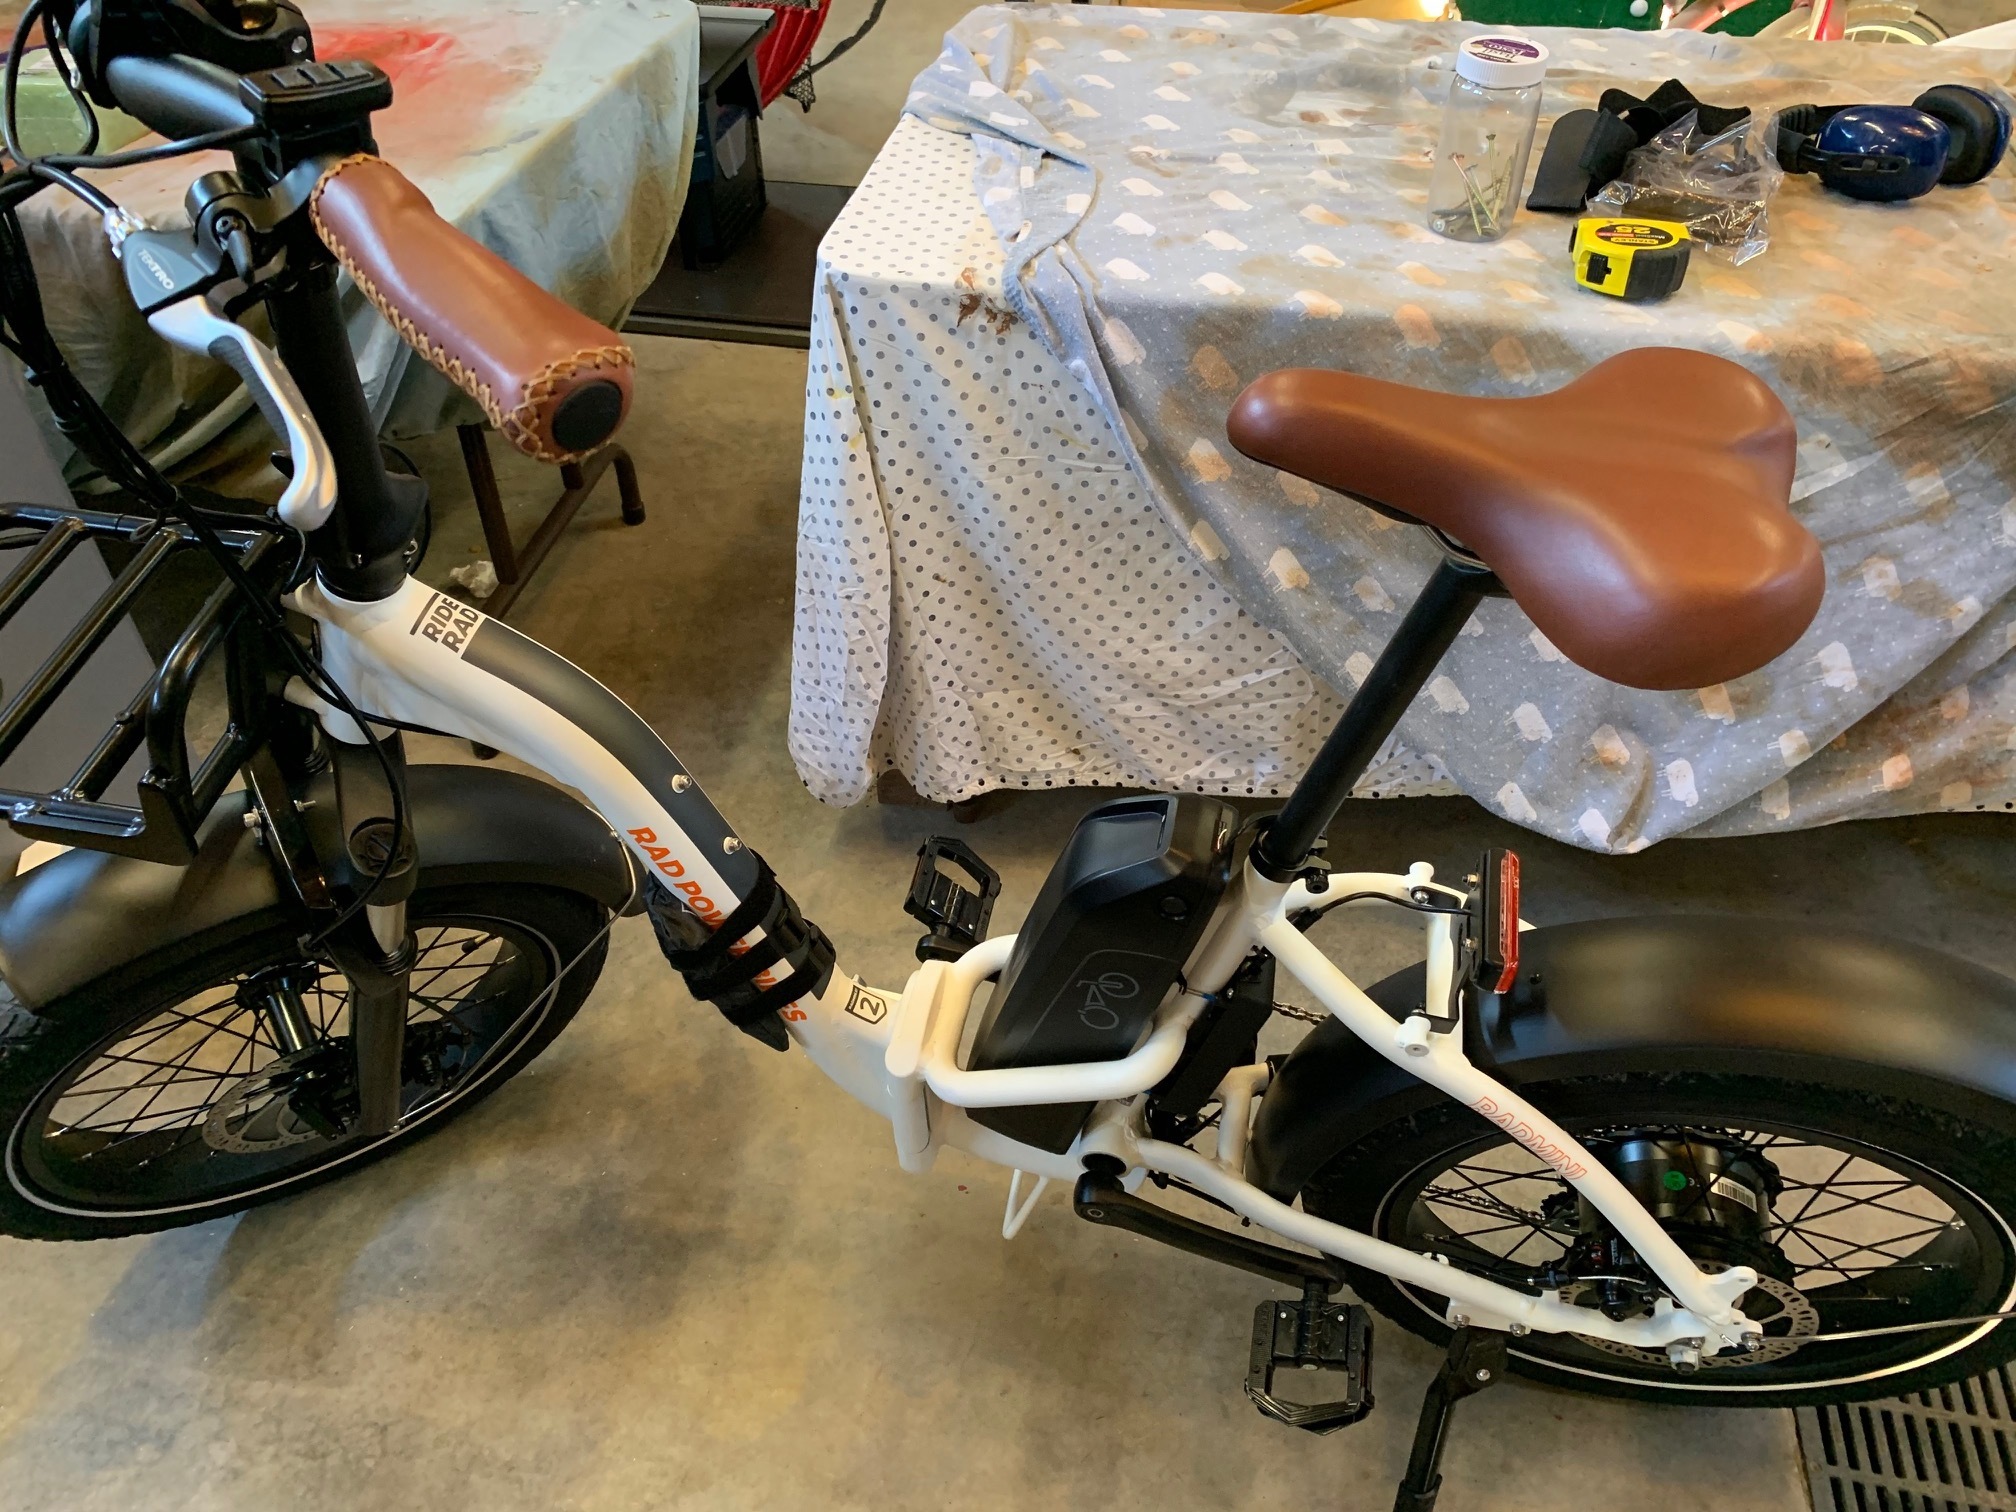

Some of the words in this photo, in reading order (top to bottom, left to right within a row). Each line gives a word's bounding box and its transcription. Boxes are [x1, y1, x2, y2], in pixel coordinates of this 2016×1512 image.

[138, 249, 174, 290] TEKTRO
[422, 597, 460, 643] RIDE
[441, 608, 479, 654] RAD
[626, 826, 685, 878] RAD
[860, 997, 880, 1016] 2
[1469, 1096, 1588, 1180] RADMINI
